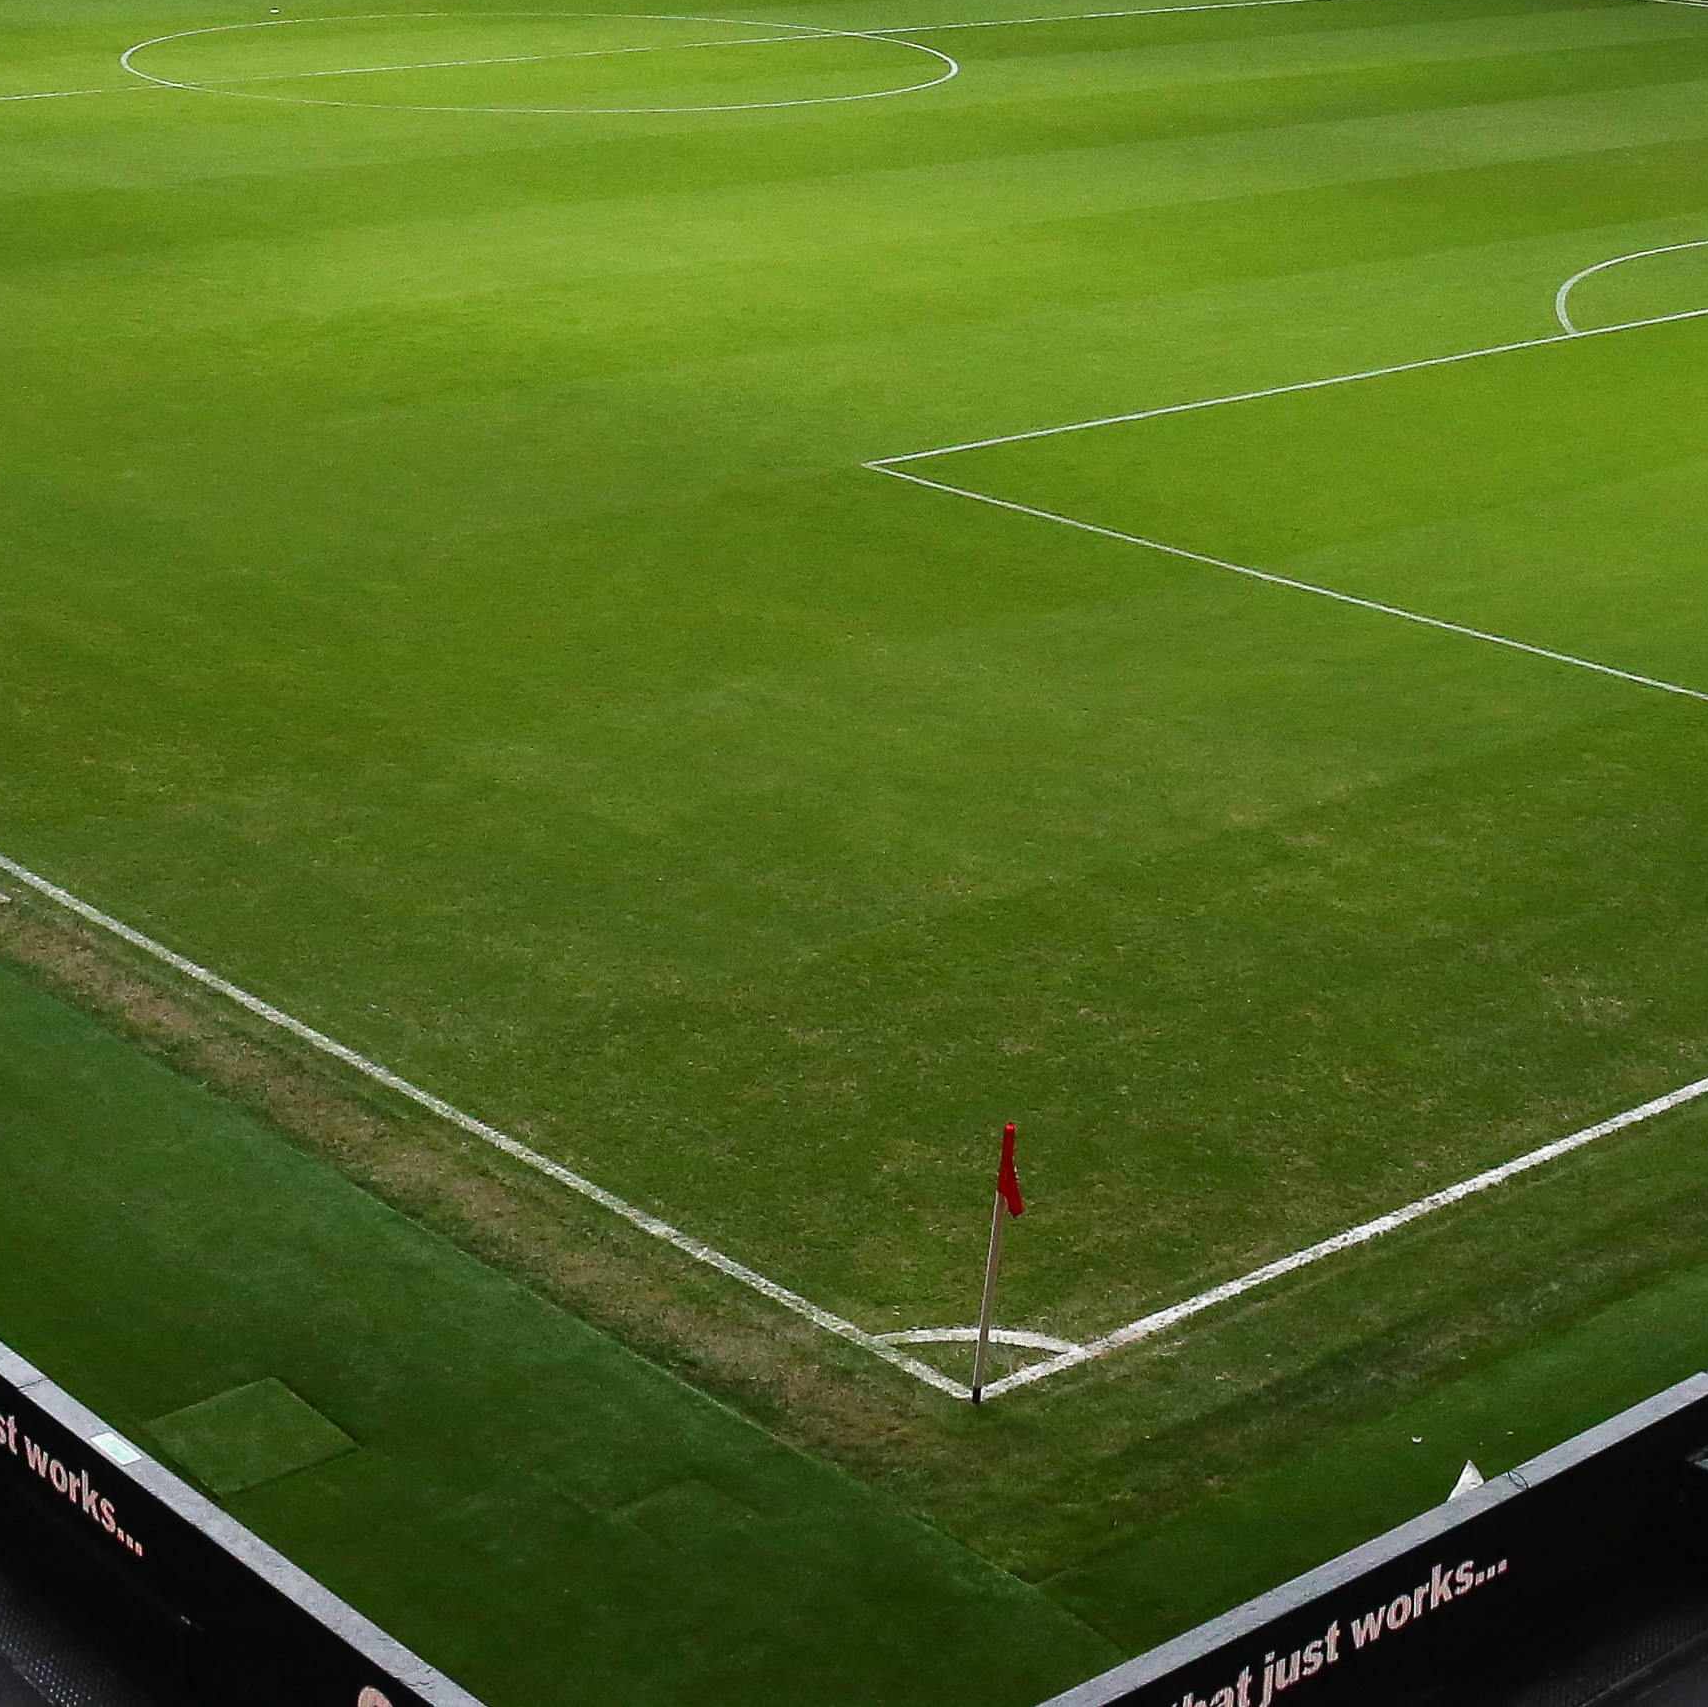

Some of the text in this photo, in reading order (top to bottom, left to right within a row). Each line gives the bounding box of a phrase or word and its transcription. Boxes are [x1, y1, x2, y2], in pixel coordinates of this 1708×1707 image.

[22, 1433, 144, 1558] works...
[1259, 1620, 1341, 1707] just
[1350, 1558, 1508, 1649] works...
